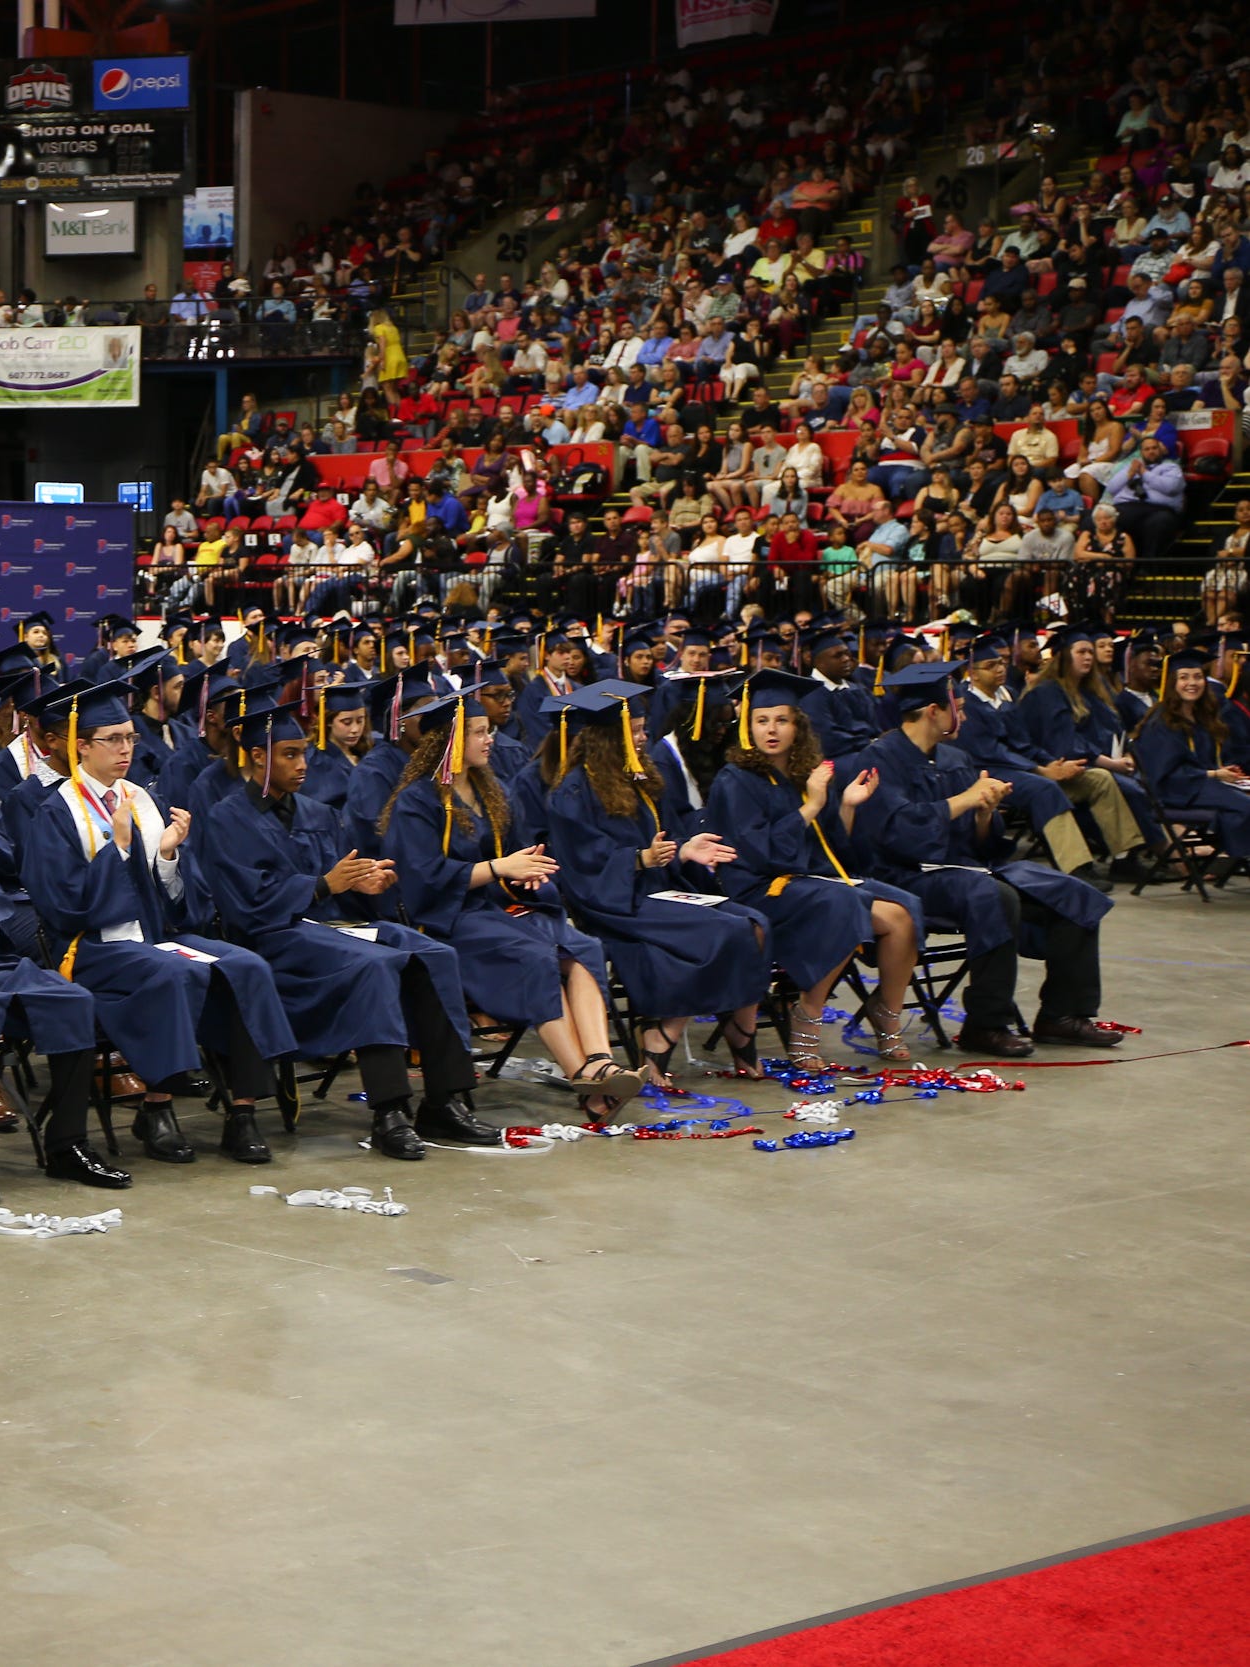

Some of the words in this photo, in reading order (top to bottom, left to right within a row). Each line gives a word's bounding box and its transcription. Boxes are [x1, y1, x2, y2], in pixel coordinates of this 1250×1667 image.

[5, 80, 72, 102] DEVILS
[132, 73, 181, 91] pepsi
[21, 126, 75, 138] SHOTS
[80, 125, 105, 135] ON
[109, 123, 155, 135] GOAL
[37, 140, 99, 154] VISITORS
[965, 145, 986, 166] 26
[935, 174, 968, 209] 26
[51, 220, 89, 236] M&T
[91, 219, 129, 236] Bank
[496, 232, 529, 263] 25
[23, 337, 56, 350] Carr
